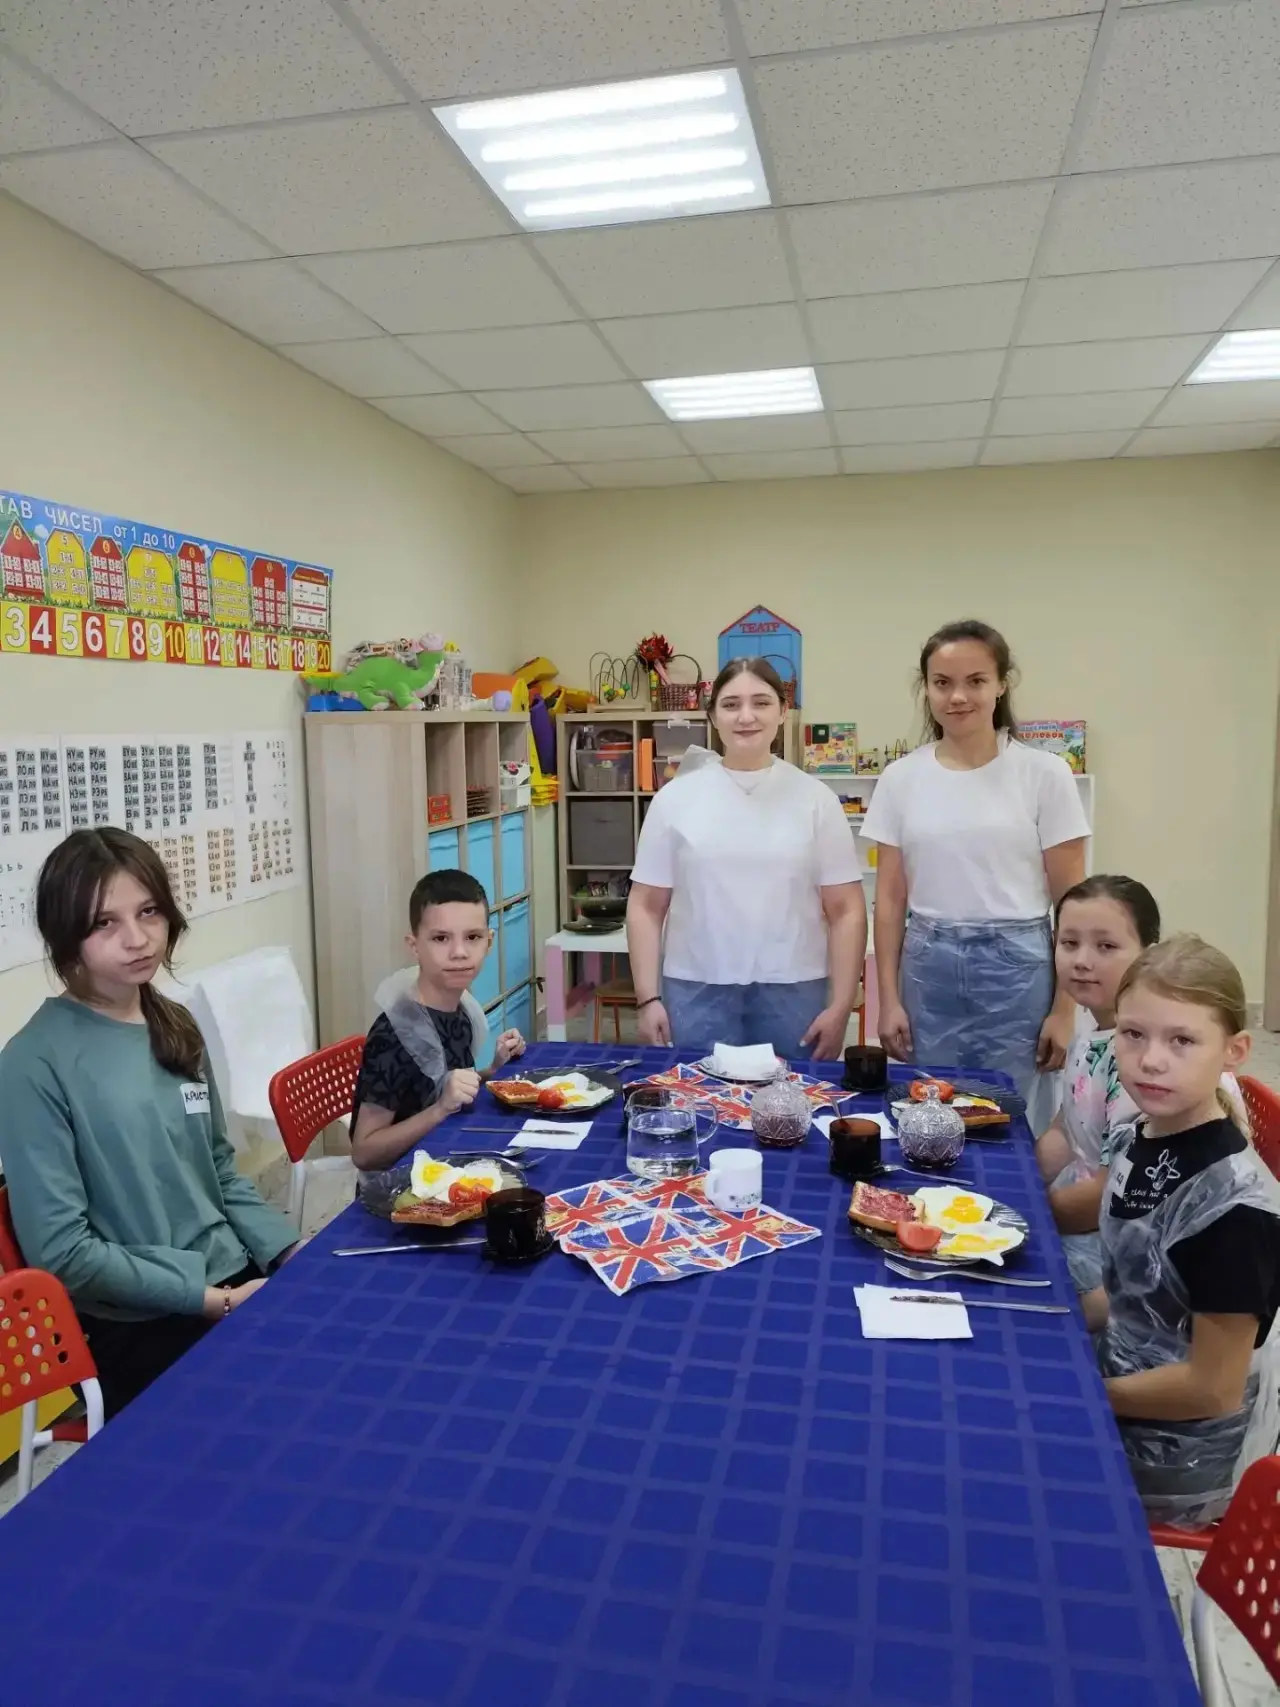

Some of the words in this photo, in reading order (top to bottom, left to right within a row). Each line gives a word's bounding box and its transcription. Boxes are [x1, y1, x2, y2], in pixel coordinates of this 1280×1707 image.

[45, 506, 102, 533] ЧИСЕЛ
[113, 525, 127, 538] от
[131, 526, 136, 541] 1
[143, 532, 158, 547] до
[163, 533, 175, 549] 10
[5, 606, 27, 648] 3
[32, 611, 52, 649] 4
[61, 612, 79, 651] 5
[85, 615, 103, 652] 6
[109, 619, 125, 654] 7
[131, 620, 146, 655] 8
[149, 622, 164, 656] 9
[165, 625, 184, 658] 10
[187, 628, 201, 659] 11
[204, 629, 220, 661] 12
[221, 632, 235, 661] 13
[236, 633, 251, 664] 14
[252, 636, 265, 664] 15
[265, 637, 278, 666] 16
[279, 638, 290, 667] 17
[292, 640, 304, 668] 18
[305, 641, 317, 667] 19
[317, 643, 330, 670] 20
[740, 623, 780, 633] ТЕАТР
